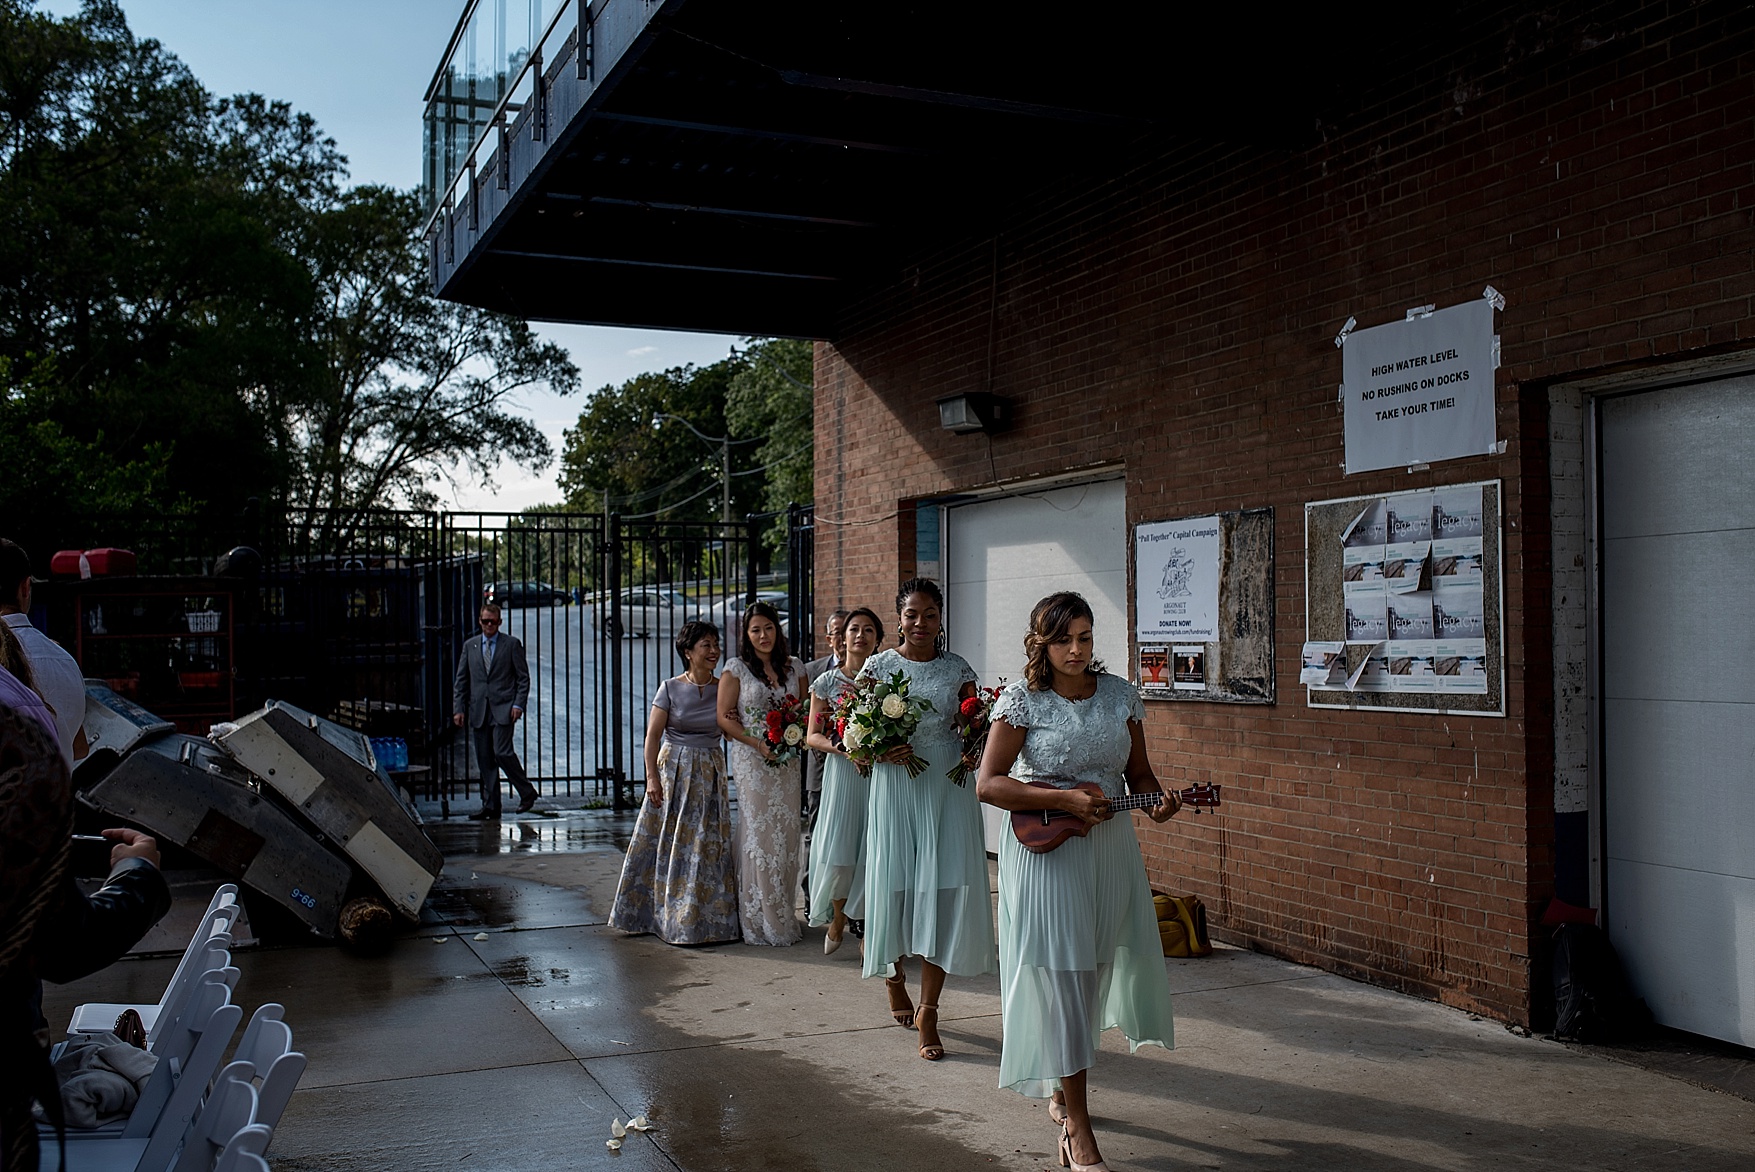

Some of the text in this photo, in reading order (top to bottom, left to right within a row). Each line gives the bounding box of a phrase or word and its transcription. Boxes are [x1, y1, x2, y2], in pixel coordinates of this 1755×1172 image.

[1371, 348, 1459, 377] HIGH WATER LEVEL
[1361, 370, 1470, 401] NO RUSHING ON DOCKS
[1375, 397, 1455, 421] TAKE YOUR TIME!
[1391, 518, 1428, 537] legacy.
[1437, 513, 1479, 532] legacy.
[1172, 529, 1191, 540] Capital
[1191, 527, 1218, 539] Campaign
[1349, 615, 1383, 635] legacy.
[1391, 614, 1429, 634] legacy.
[1438, 613, 1479, 633] legacy.
[291, 888, 316, 908] 9-66
